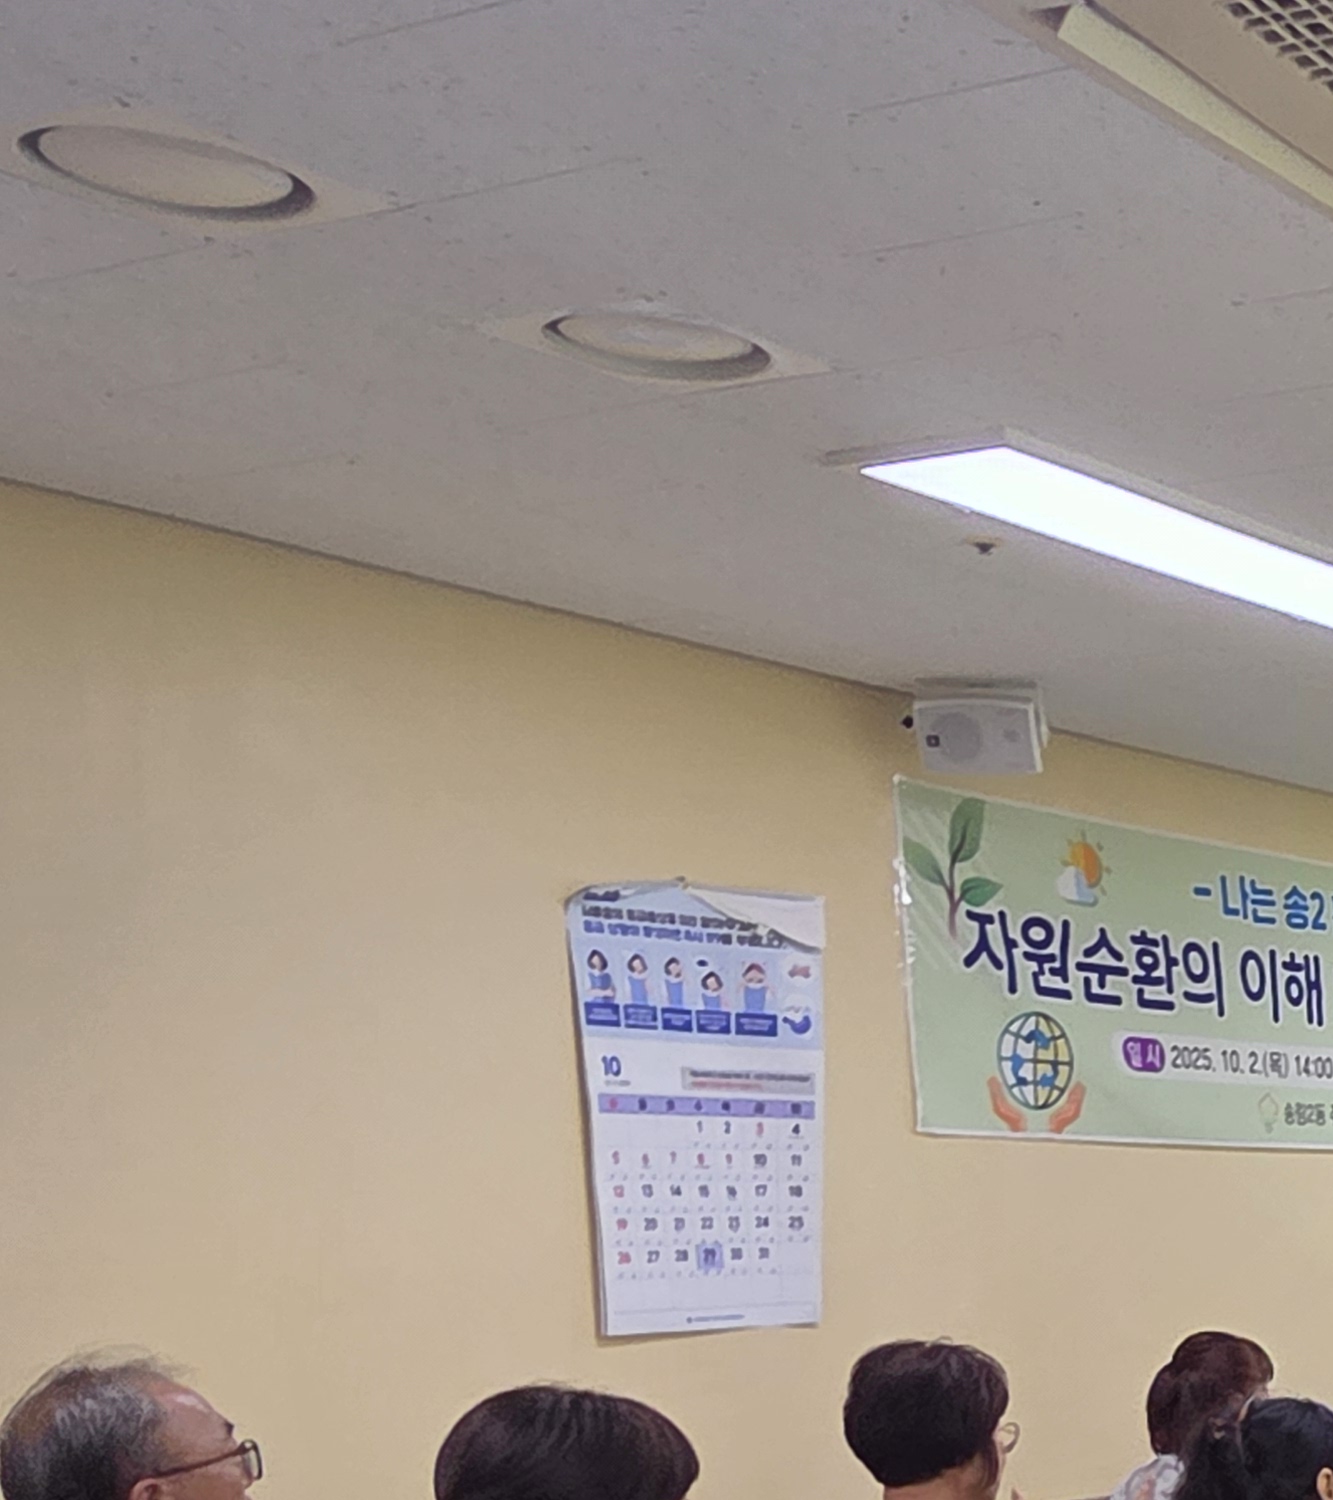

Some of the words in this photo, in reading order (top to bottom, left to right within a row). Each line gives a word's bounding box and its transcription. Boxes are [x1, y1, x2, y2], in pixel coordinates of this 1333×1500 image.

[1219, 875, 1277, 925] 나는
[1283, 885, 1327, 931] 송2
[962, 908, 1225, 1018] 자원순환의
[1240, 949, 1324, 1027] 이해
[601, 1055, 621, 1077] 10
[1125, 1041, 1161, 1069] 일시
[1170, 1045, 1216, 1072] 2025.
[1221, 1049, 1245, 1075] 10.
[1294, 1055, 1333, 1079] 14:00
